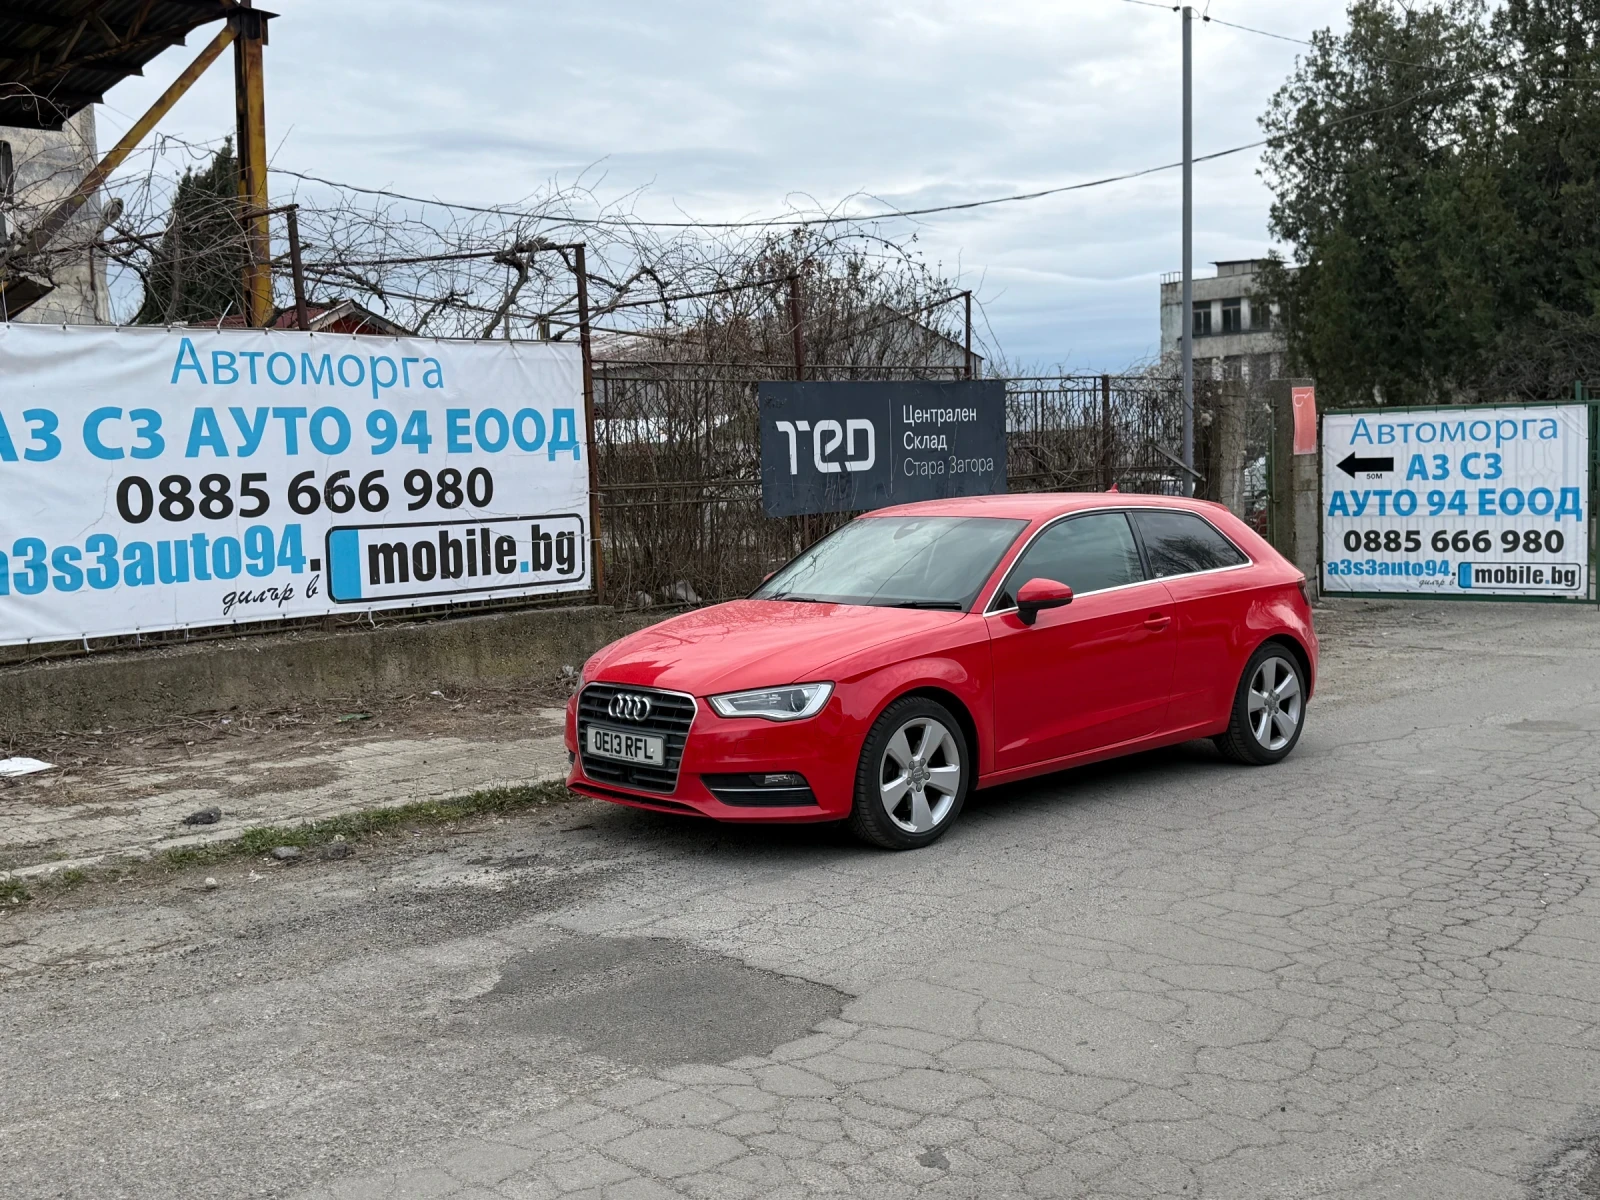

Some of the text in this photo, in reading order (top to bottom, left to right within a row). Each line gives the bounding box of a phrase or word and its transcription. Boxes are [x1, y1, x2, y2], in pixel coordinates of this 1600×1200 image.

[171, 337, 444, 399] Автоморга
[903, 405, 977, 426] Централен
[185, 405, 352, 458] АУТО
[366, 408, 432, 455] 94
[446, 408, 581, 461] ЕООД
[903, 431, 947, 451] Склад
[1350, 417, 1558, 448] Автоморга
[904, 455, 994, 479] Стара Загора
[117, 467, 494, 524] 0885 666 980
[1327, 487, 1582, 522] АУТО 94 ЕООД
[368, 524, 576, 585] mobile.bg
[1343, 530, 1564, 553] 0885 666 980
[1475, 566, 1576, 587] mobile.bg
[595, 731, 653, 760] OE13 RFL
